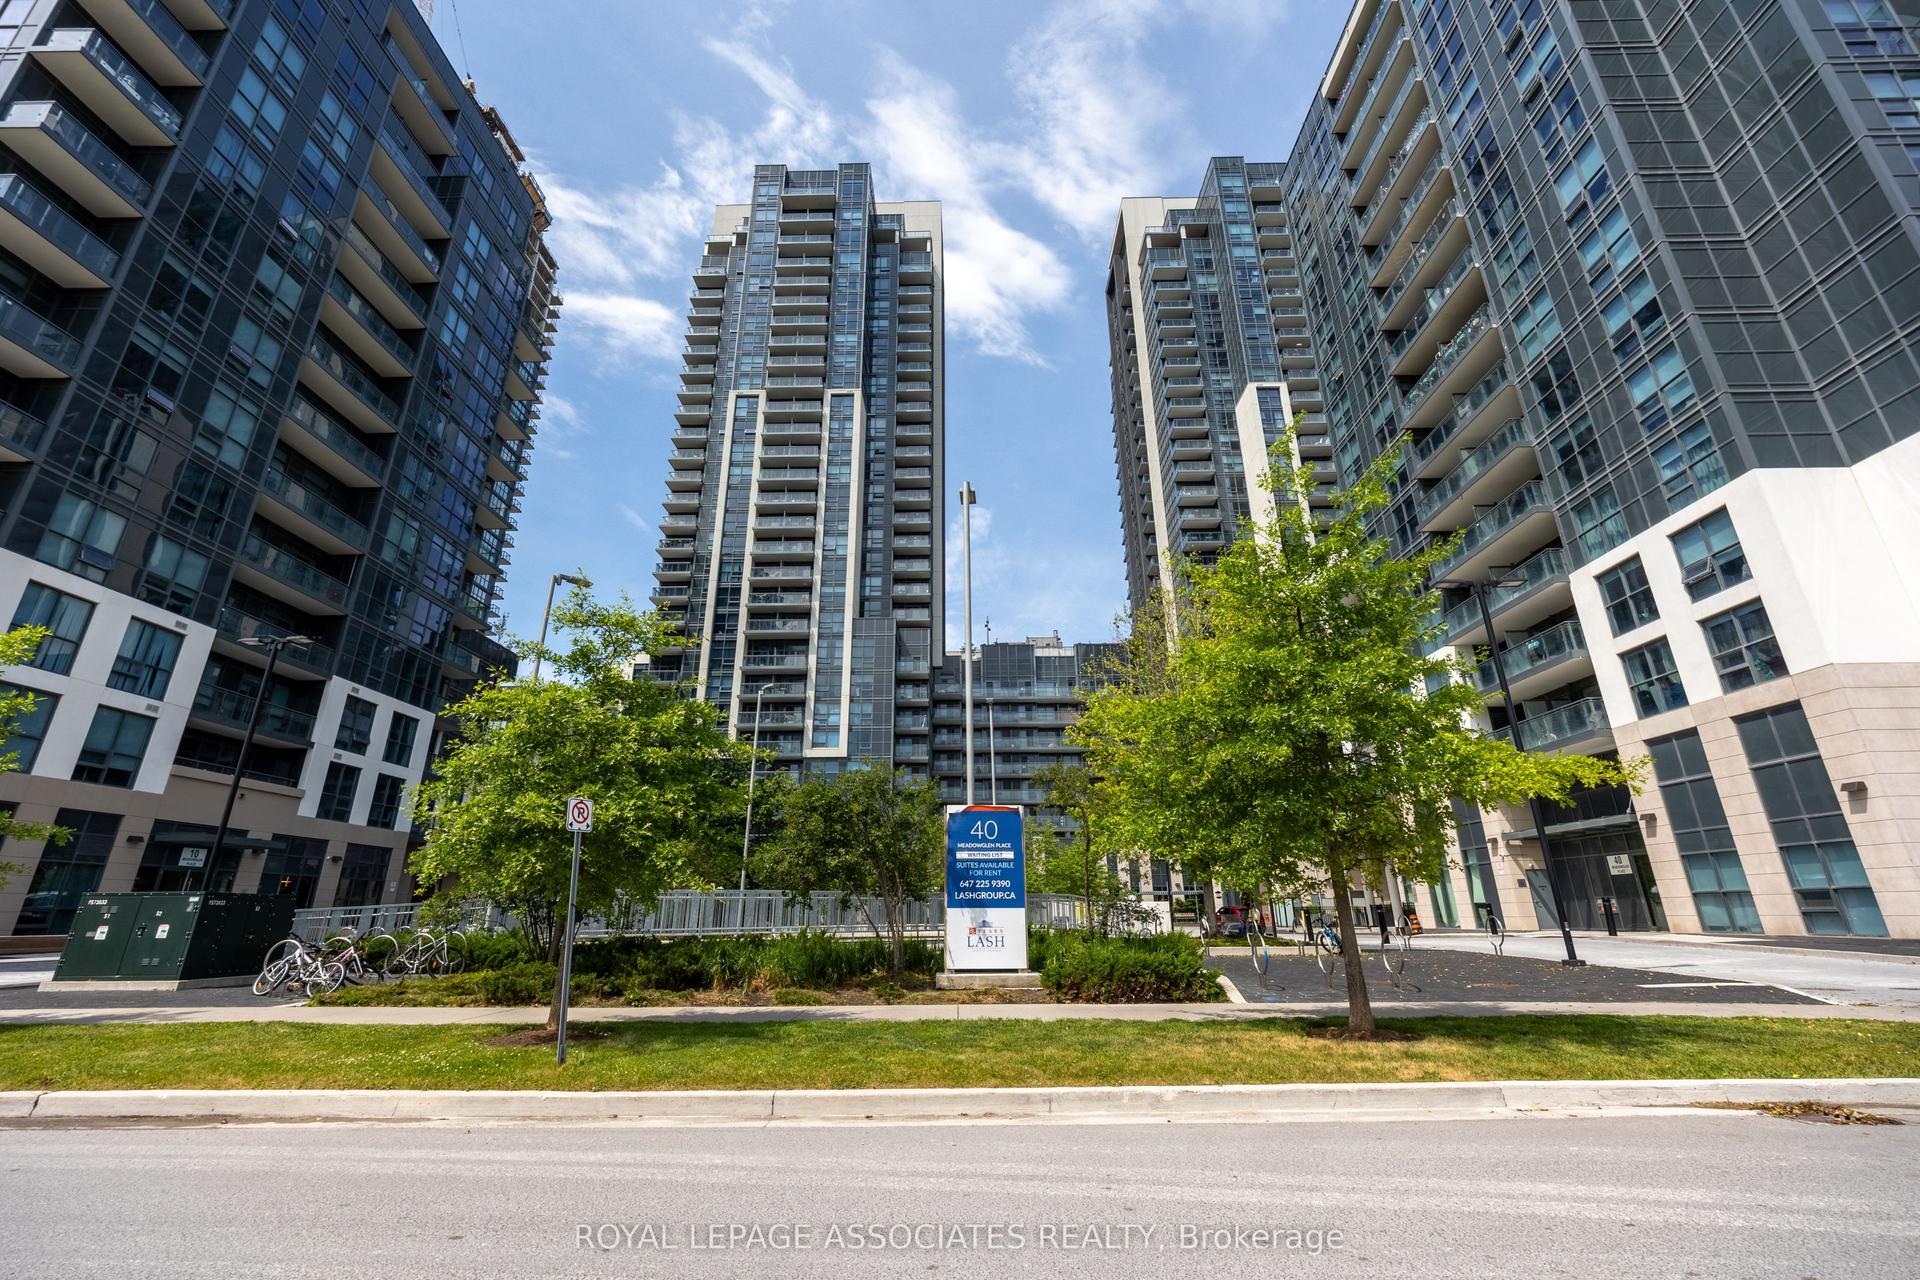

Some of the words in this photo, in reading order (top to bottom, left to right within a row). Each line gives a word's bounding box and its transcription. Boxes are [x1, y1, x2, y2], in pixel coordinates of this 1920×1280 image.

[970, 820, 998, 840] 40
[190, 849, 200, 858] 10
[1614, 856, 1623, 864] 40
[956, 861, 979, 869] SUITES
[979, 861, 1015, 869] AVAILABLE
[959, 880, 974, 888] 647
[975, 880, 990, 888] 225
[991, 880, 1011, 888] 9390
[954, 891, 1016, 900] LASHGROUP.CA
[967, 935, 1005, 948] LASH
